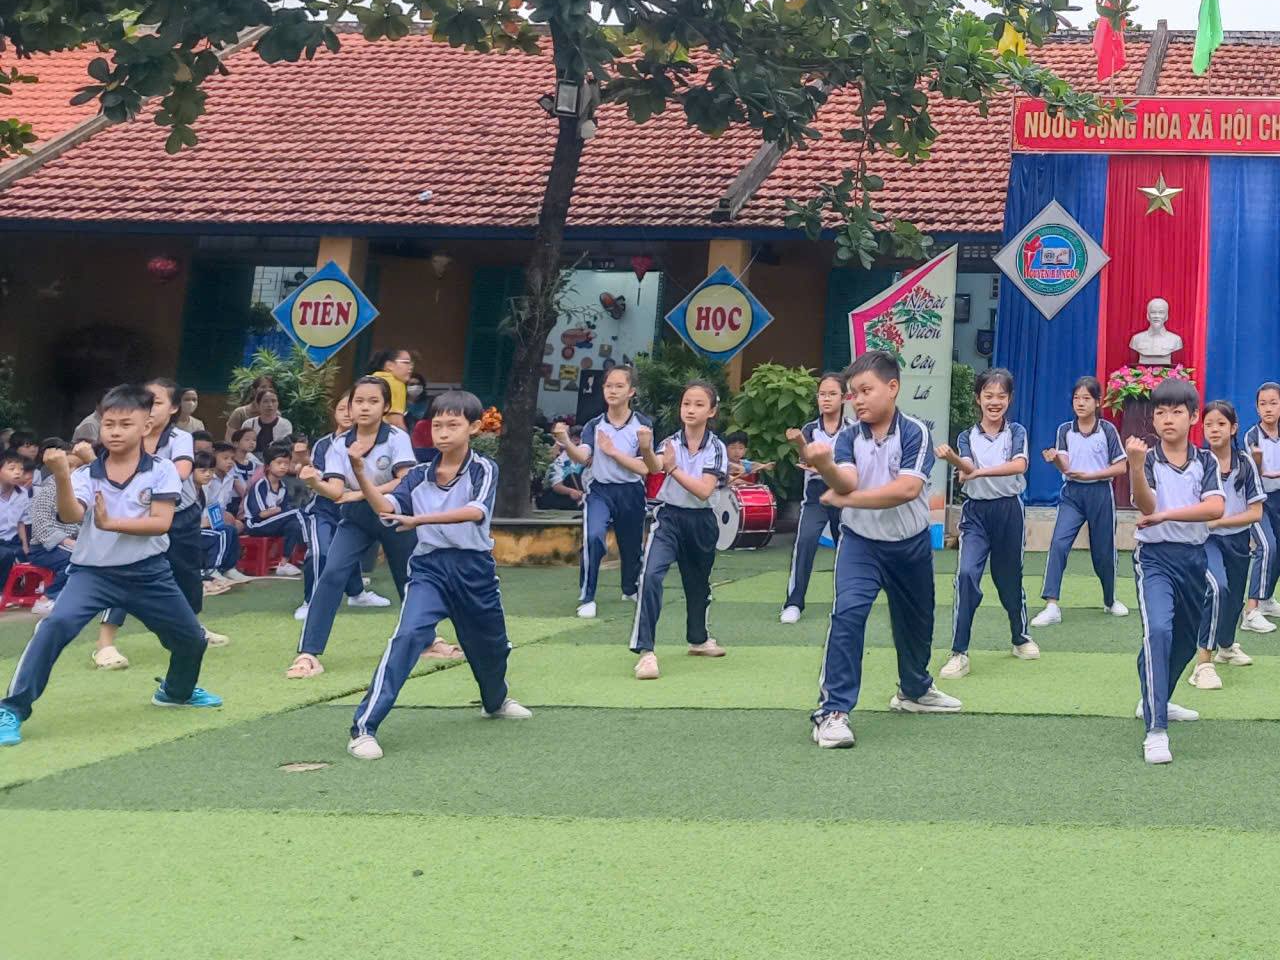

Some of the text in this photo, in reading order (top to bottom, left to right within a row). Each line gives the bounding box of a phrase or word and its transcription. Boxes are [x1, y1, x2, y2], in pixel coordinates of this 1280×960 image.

[1143, 107, 1182, 140] HÒA
[1187, 108, 1214, 140] XÃ
[1220, 108, 1252, 146] HỘI
[299, 294, 352, 326] TIÊN
[695, 306, 742, 337] HỌC
